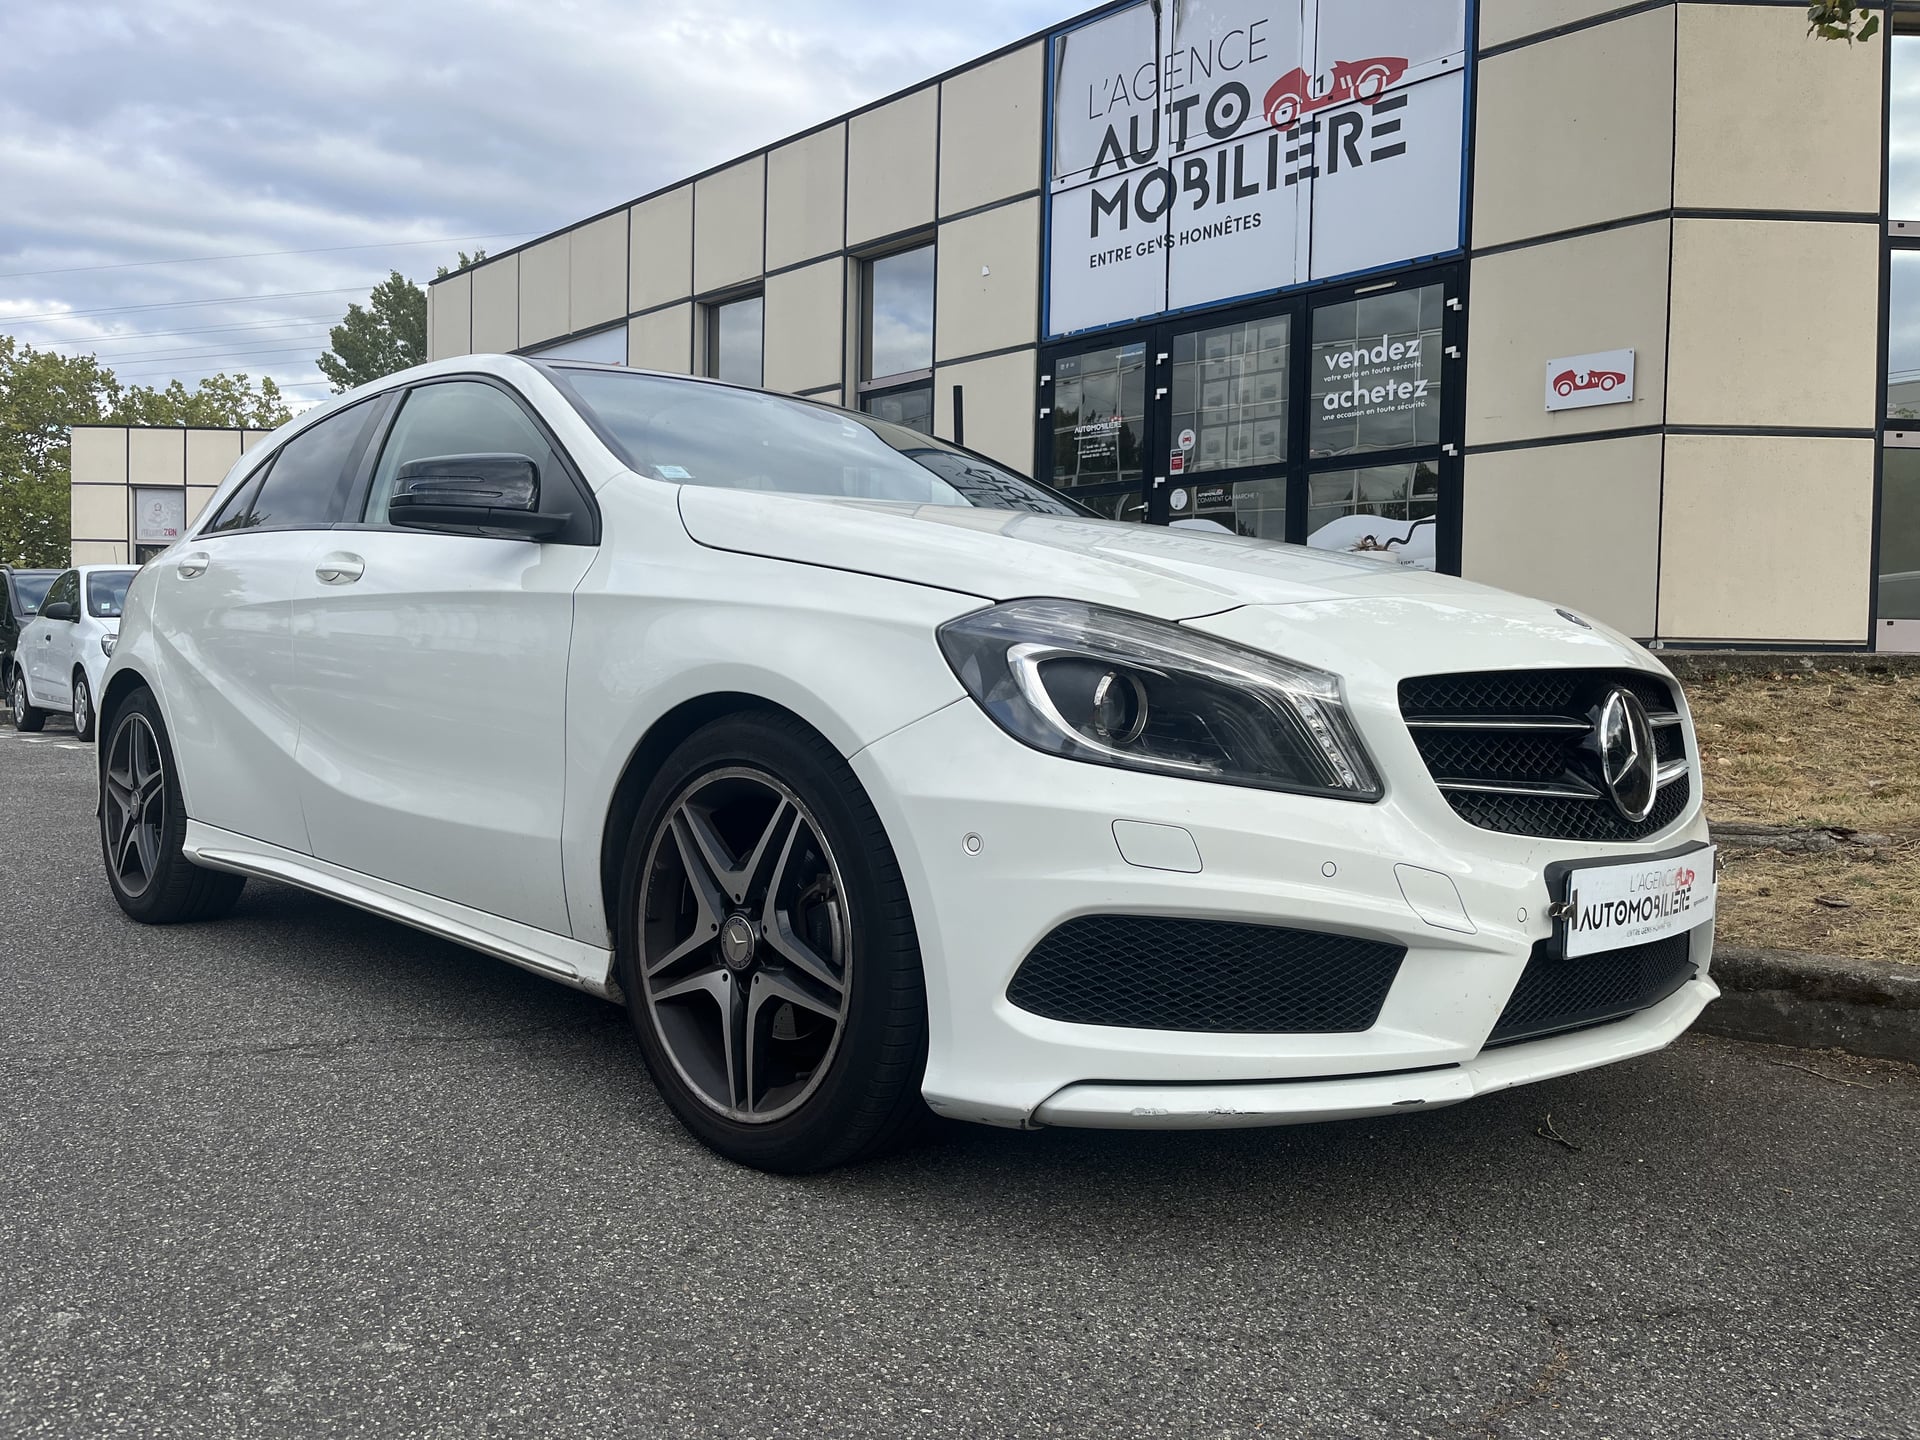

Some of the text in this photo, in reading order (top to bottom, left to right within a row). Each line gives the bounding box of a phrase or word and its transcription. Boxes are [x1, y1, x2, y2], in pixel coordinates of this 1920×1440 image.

[1088, 19, 1269, 120] L'AGENCE
[1089, 81, 1251, 180] AUTO
[1089, 212, 1262, 269] ENTRE GENS HONNÊTES
[1325, 334, 1420, 371] vendez
[1343, 371, 1359, 379] auto
[1372, 366, 1391, 374] toute
[1323, 379, 1428, 410] achetez
[1336, 409, 1365, 419] occasion
[1377, 405, 1395, 413] toute
